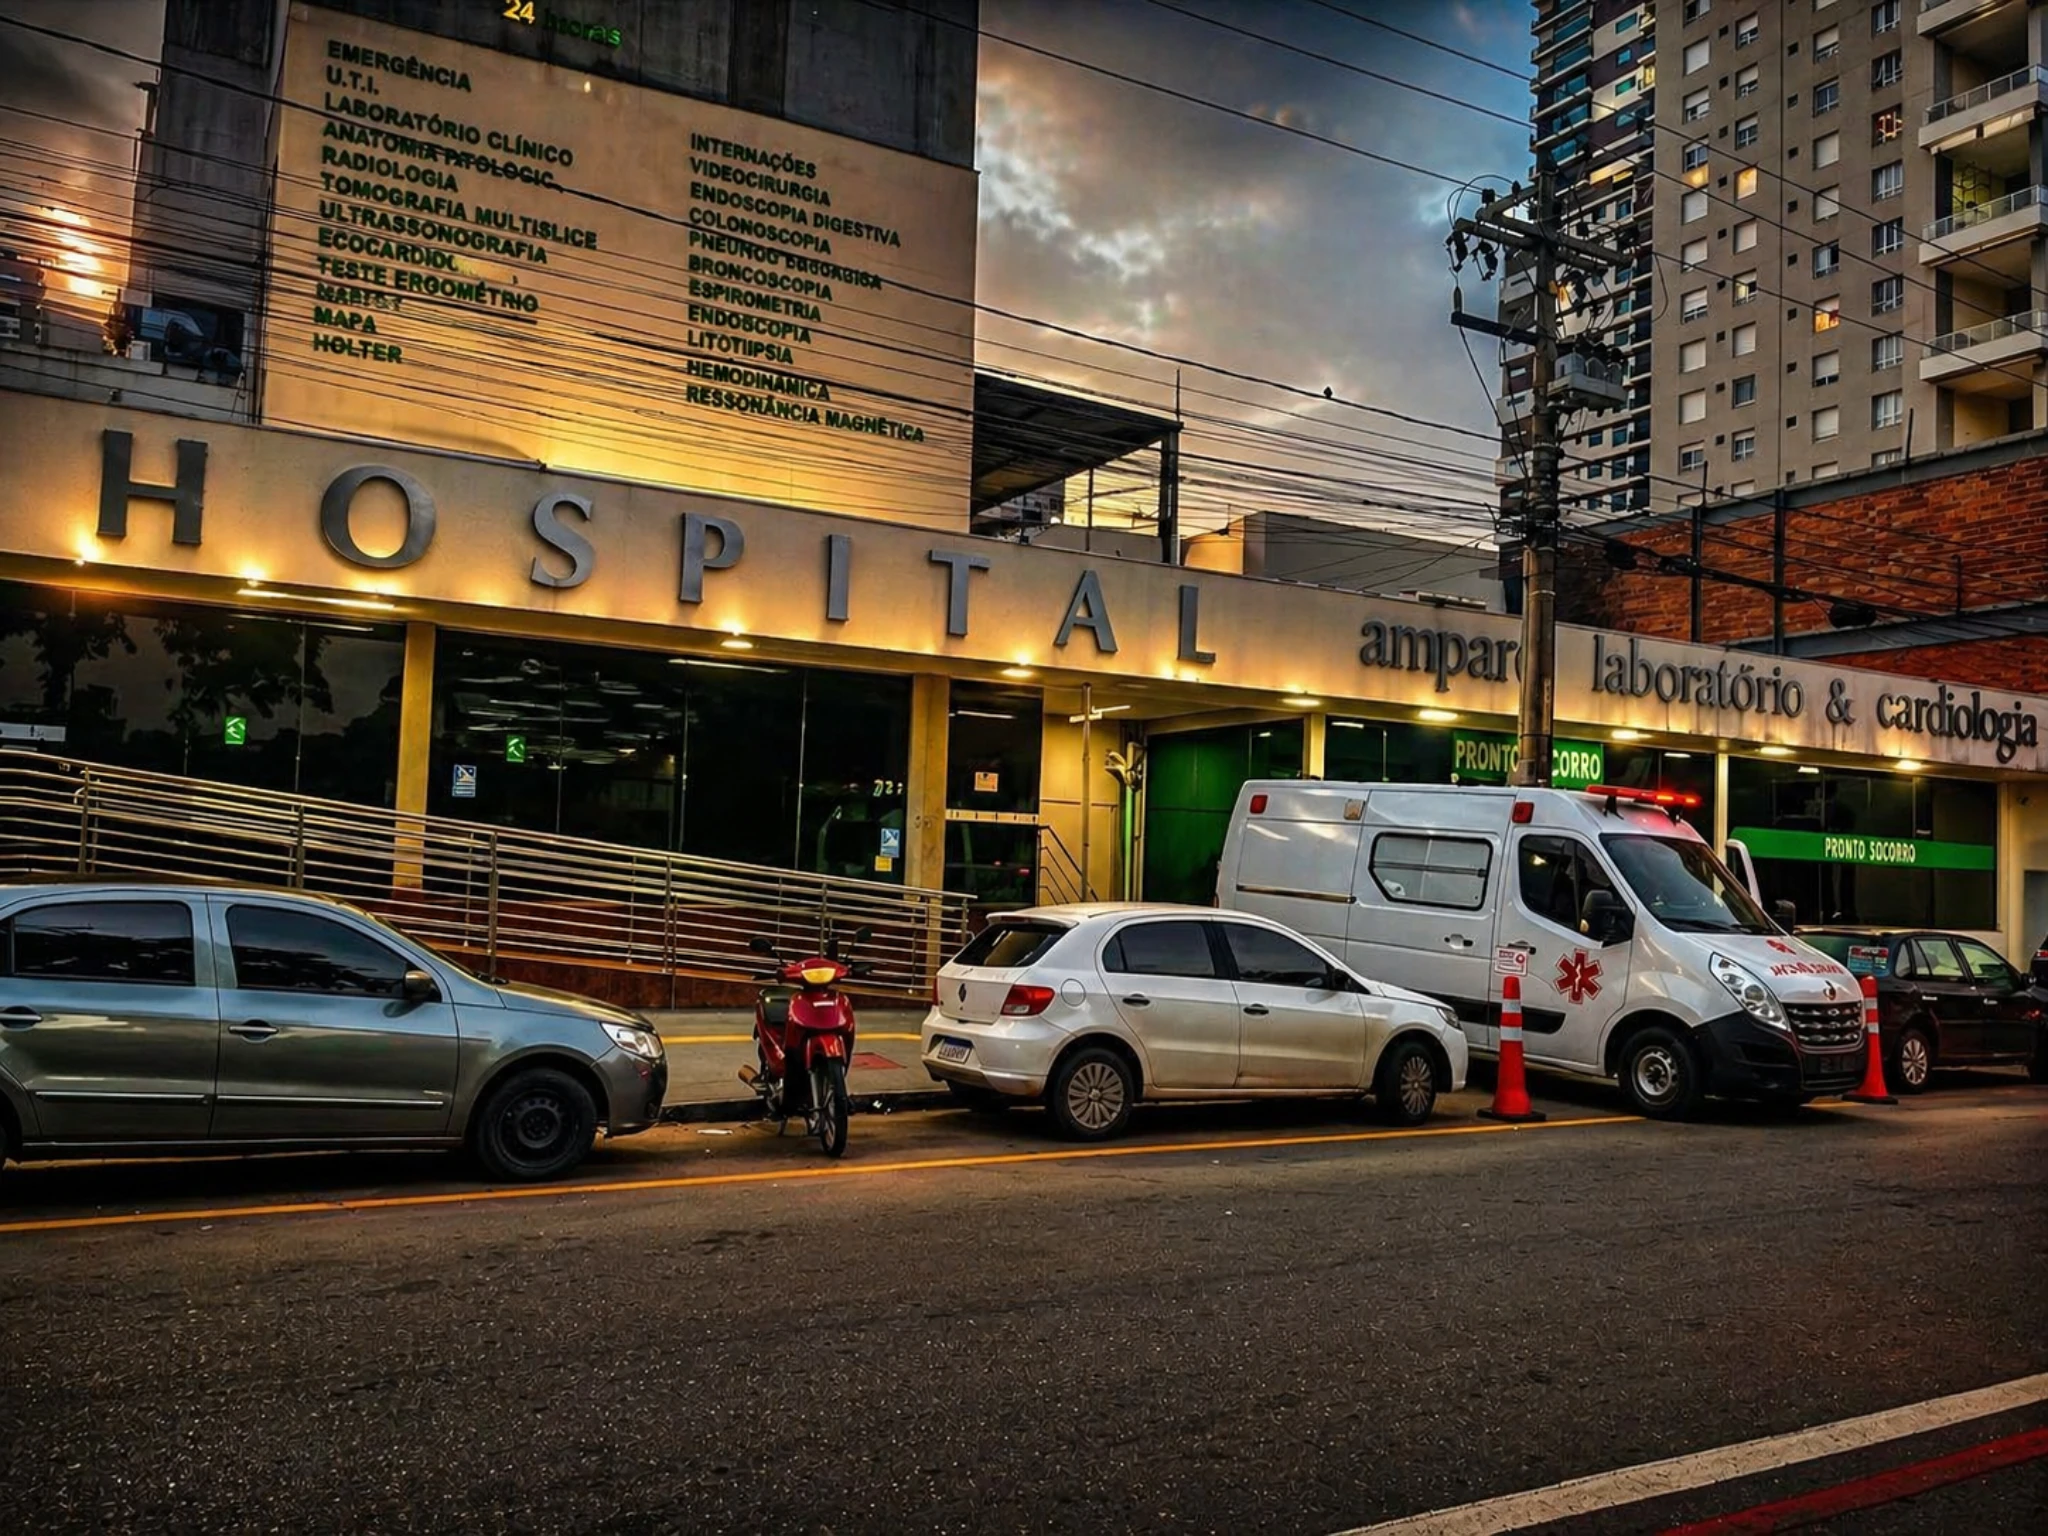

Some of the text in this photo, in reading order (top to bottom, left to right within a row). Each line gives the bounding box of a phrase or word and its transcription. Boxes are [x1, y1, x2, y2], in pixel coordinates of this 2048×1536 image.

[502, 0, 536, 24] 24
[326, 65, 380, 95] U.T.I.
[327, 39, 472, 93] EMERGÊNCIA
[325, 92, 574, 168] LABORATÓRIO CLÍNICO
[322, 145, 458, 193] RADIOLOGIA
[690, 133, 817, 179] INTERNAÇÕES
[689, 157, 831, 207] VIDEOCIRURGIA
[319, 199, 547, 264] ULTRASSONOGRAFIA
[320, 171, 597, 250] TOMOGRAFIA MULTISLICE
[689, 207, 831, 255] COLONOSCOPIA
[690, 182, 901, 248] ENDOSCOPIA DIGESTIVA
[317, 256, 387, 287] TESTE
[689, 254, 832, 301] BRONCOSCOPIA
[313, 306, 376, 334] MAPA
[688, 276, 822, 322] ESPIROMETRIA
[312, 332, 402, 363] HOLTER
[688, 304, 811, 344] ENDOSCOPIA
[686, 385, 820, 425] RESSONÂNCIA
[97, 428, 1215, 663] HOSPITAL
[1359, 620, 2038, 764] ampar laboratório & cardiologia
[1825, 837, 1916, 864] PRONTO SOCORRO
